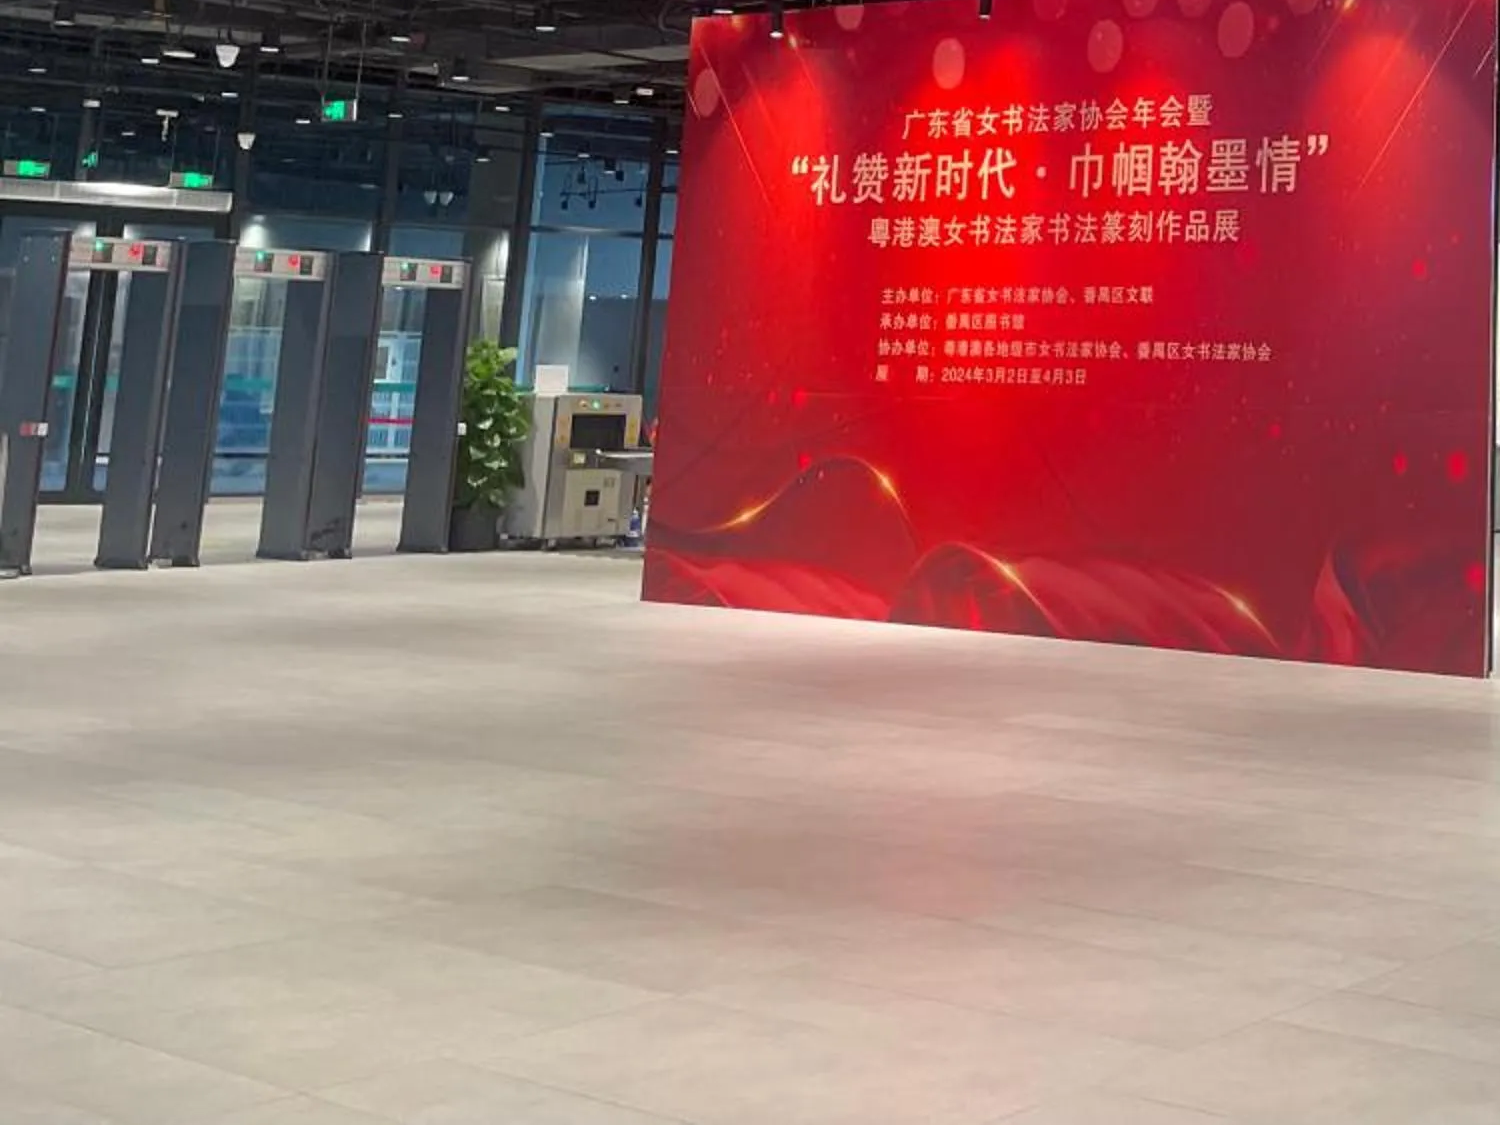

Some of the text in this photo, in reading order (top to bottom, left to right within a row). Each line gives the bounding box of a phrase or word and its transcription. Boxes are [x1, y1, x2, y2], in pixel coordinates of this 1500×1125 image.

[902, 94, 1213, 140] 广东省女书法家协会年会暨
[868, 209, 1240, 248] 粤港澳女书法家书法篆刻作品展
